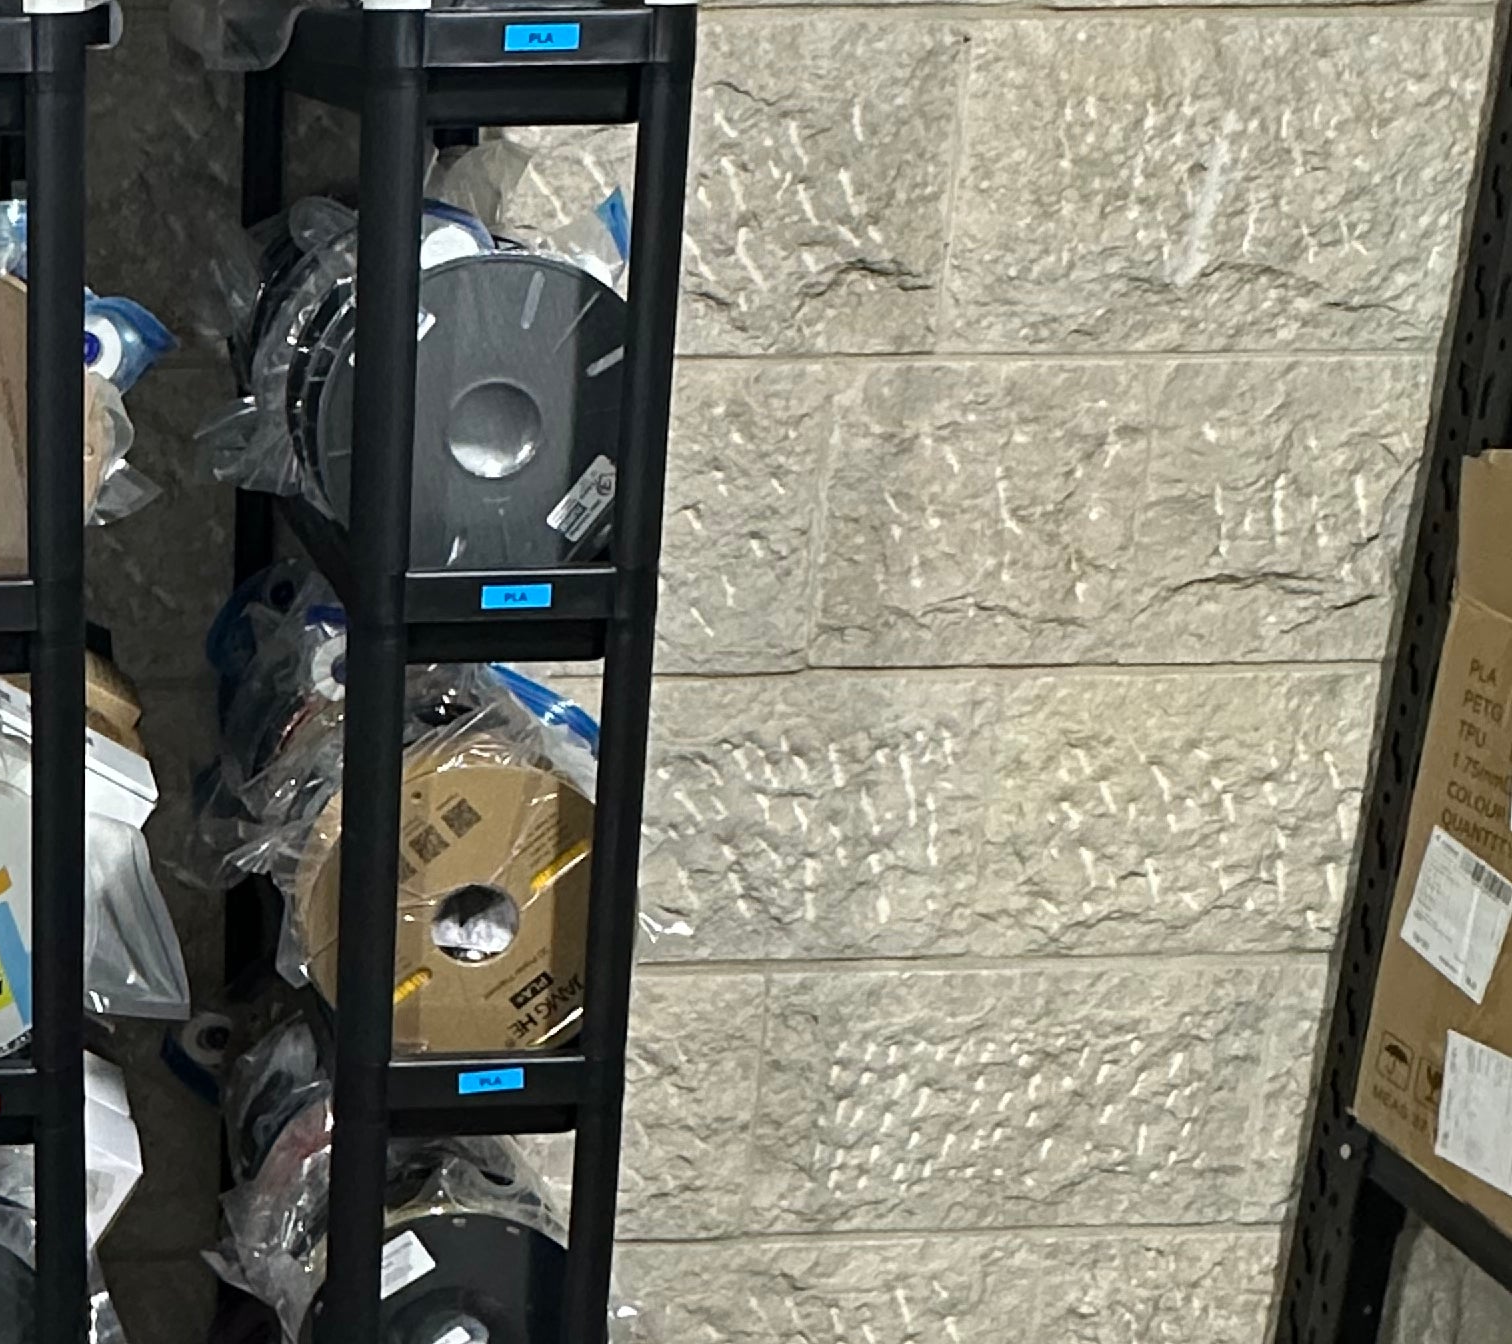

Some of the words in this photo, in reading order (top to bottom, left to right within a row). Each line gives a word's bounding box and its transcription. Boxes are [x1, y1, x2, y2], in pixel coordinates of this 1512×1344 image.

[528, 32, 554, 44] PLA
[504, 592, 528, 602] PLA
[1468, 658, 1497, 688] PLA
[1458, 718, 1487, 749] TPU
